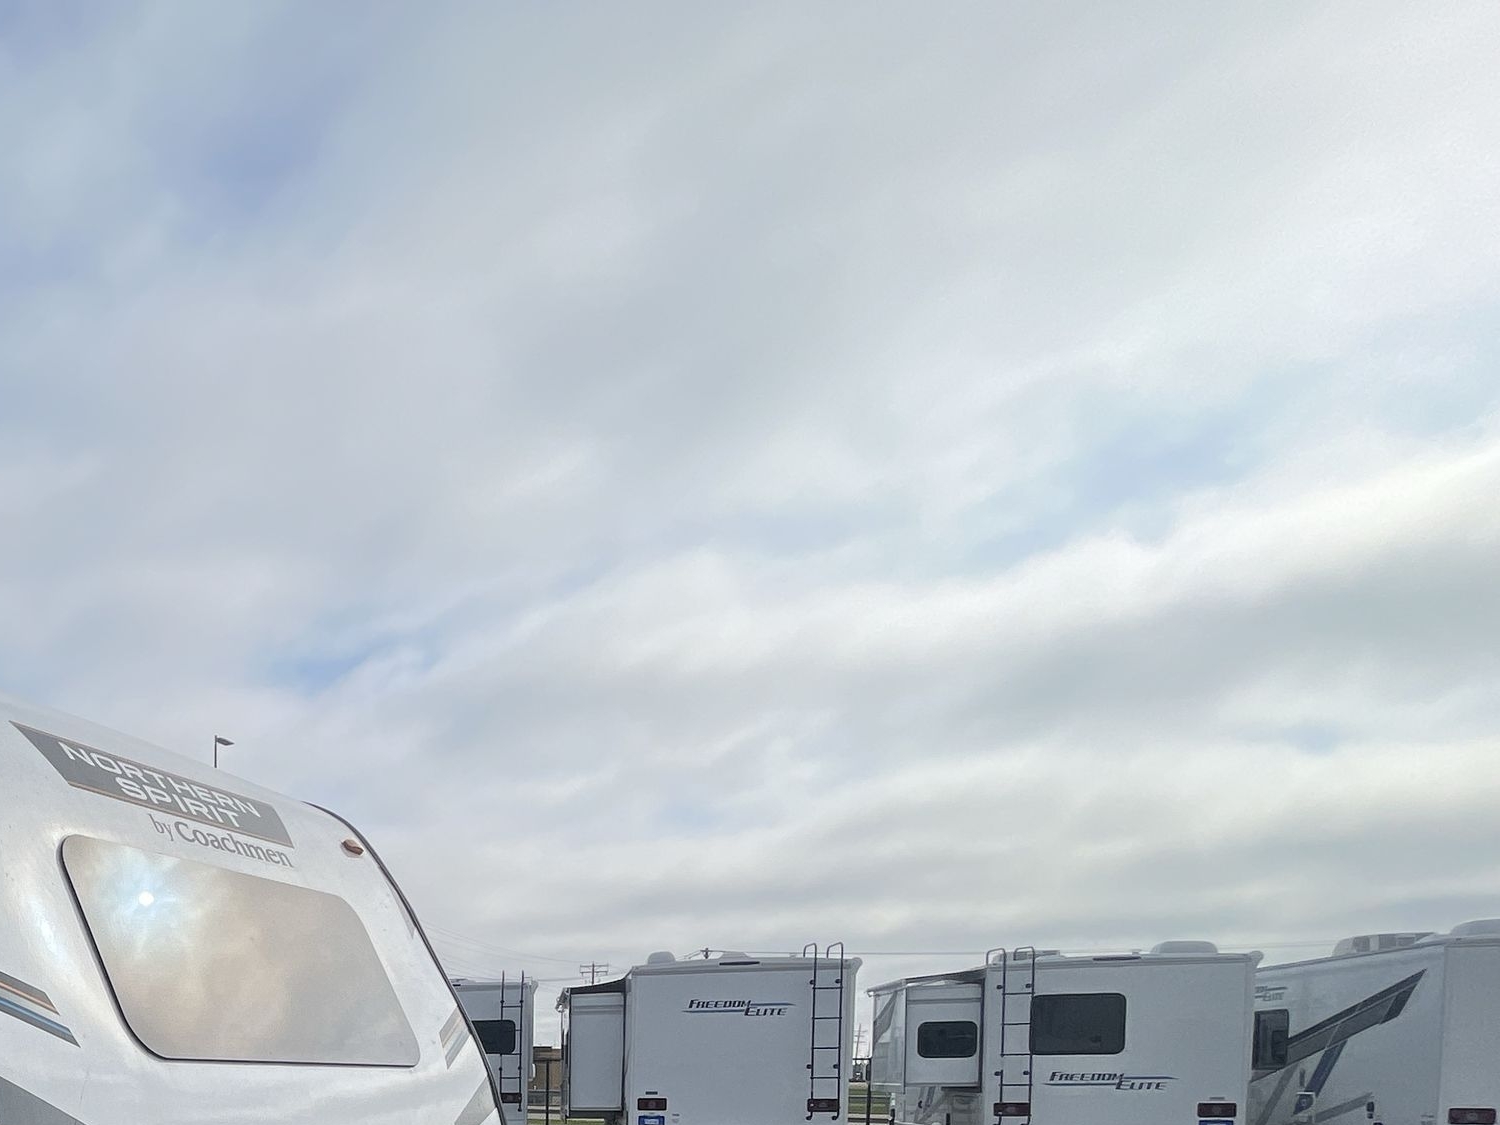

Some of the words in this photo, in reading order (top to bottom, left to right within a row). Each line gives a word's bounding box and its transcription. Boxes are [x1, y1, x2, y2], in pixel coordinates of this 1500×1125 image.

[58, 741, 261, 818] NORTHERN
[115, 776, 241, 828] SPIRIT
[148, 813, 174, 841] by
[174, 820, 294, 868] Coachmen
[688, 999, 751, 1009] FREEDOM
[744, 1007, 788, 1017] ELITE
[1049, 1071, 1125, 1082] FREEDOM
[1115, 1079, 1169, 1090] ELITE
